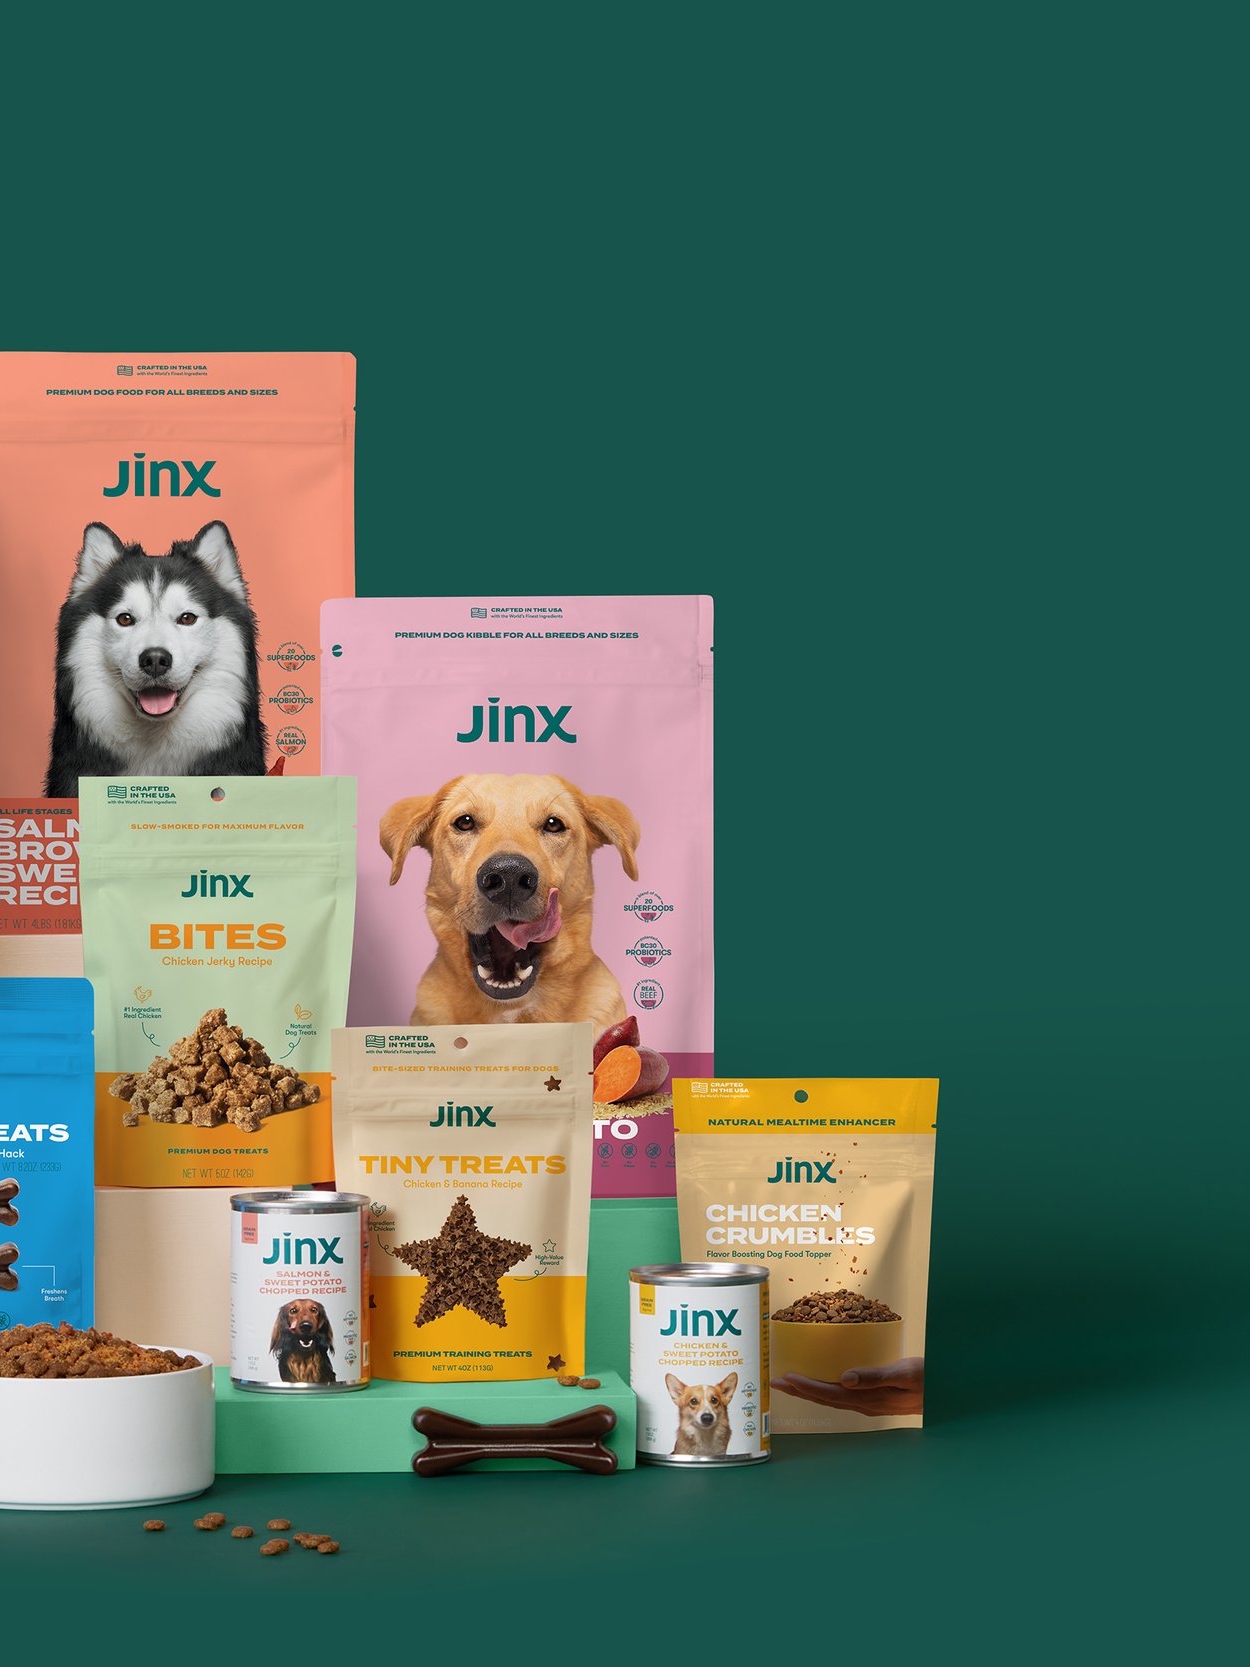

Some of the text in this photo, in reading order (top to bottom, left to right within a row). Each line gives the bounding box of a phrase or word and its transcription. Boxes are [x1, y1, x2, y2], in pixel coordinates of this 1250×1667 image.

[149, 923, 287, 950] BITES
[161, 956, 273, 968] Chicken Jerky Recipe
[123, 1006, 162, 1015] #1 Ingredient
[358, 1154, 567, 1175] TINY TREATS
[403, 1179, 442, 1189] Chicken
[452, 1179, 489, 1189] Banana
[491, 1179, 523, 1190] Recipe
[705, 1203, 842, 1222] CHICKEN
[705, 1226, 876, 1245] CRUMBLES
[302, 1278, 342, 1286] POTATO
[311, 1285, 347, 1295] RECIPE
[393, 1350, 442, 1358] PREMIUM
[699, 1349, 739, 1358] POTATO
[708, 1357, 744, 1367] RECIPE
